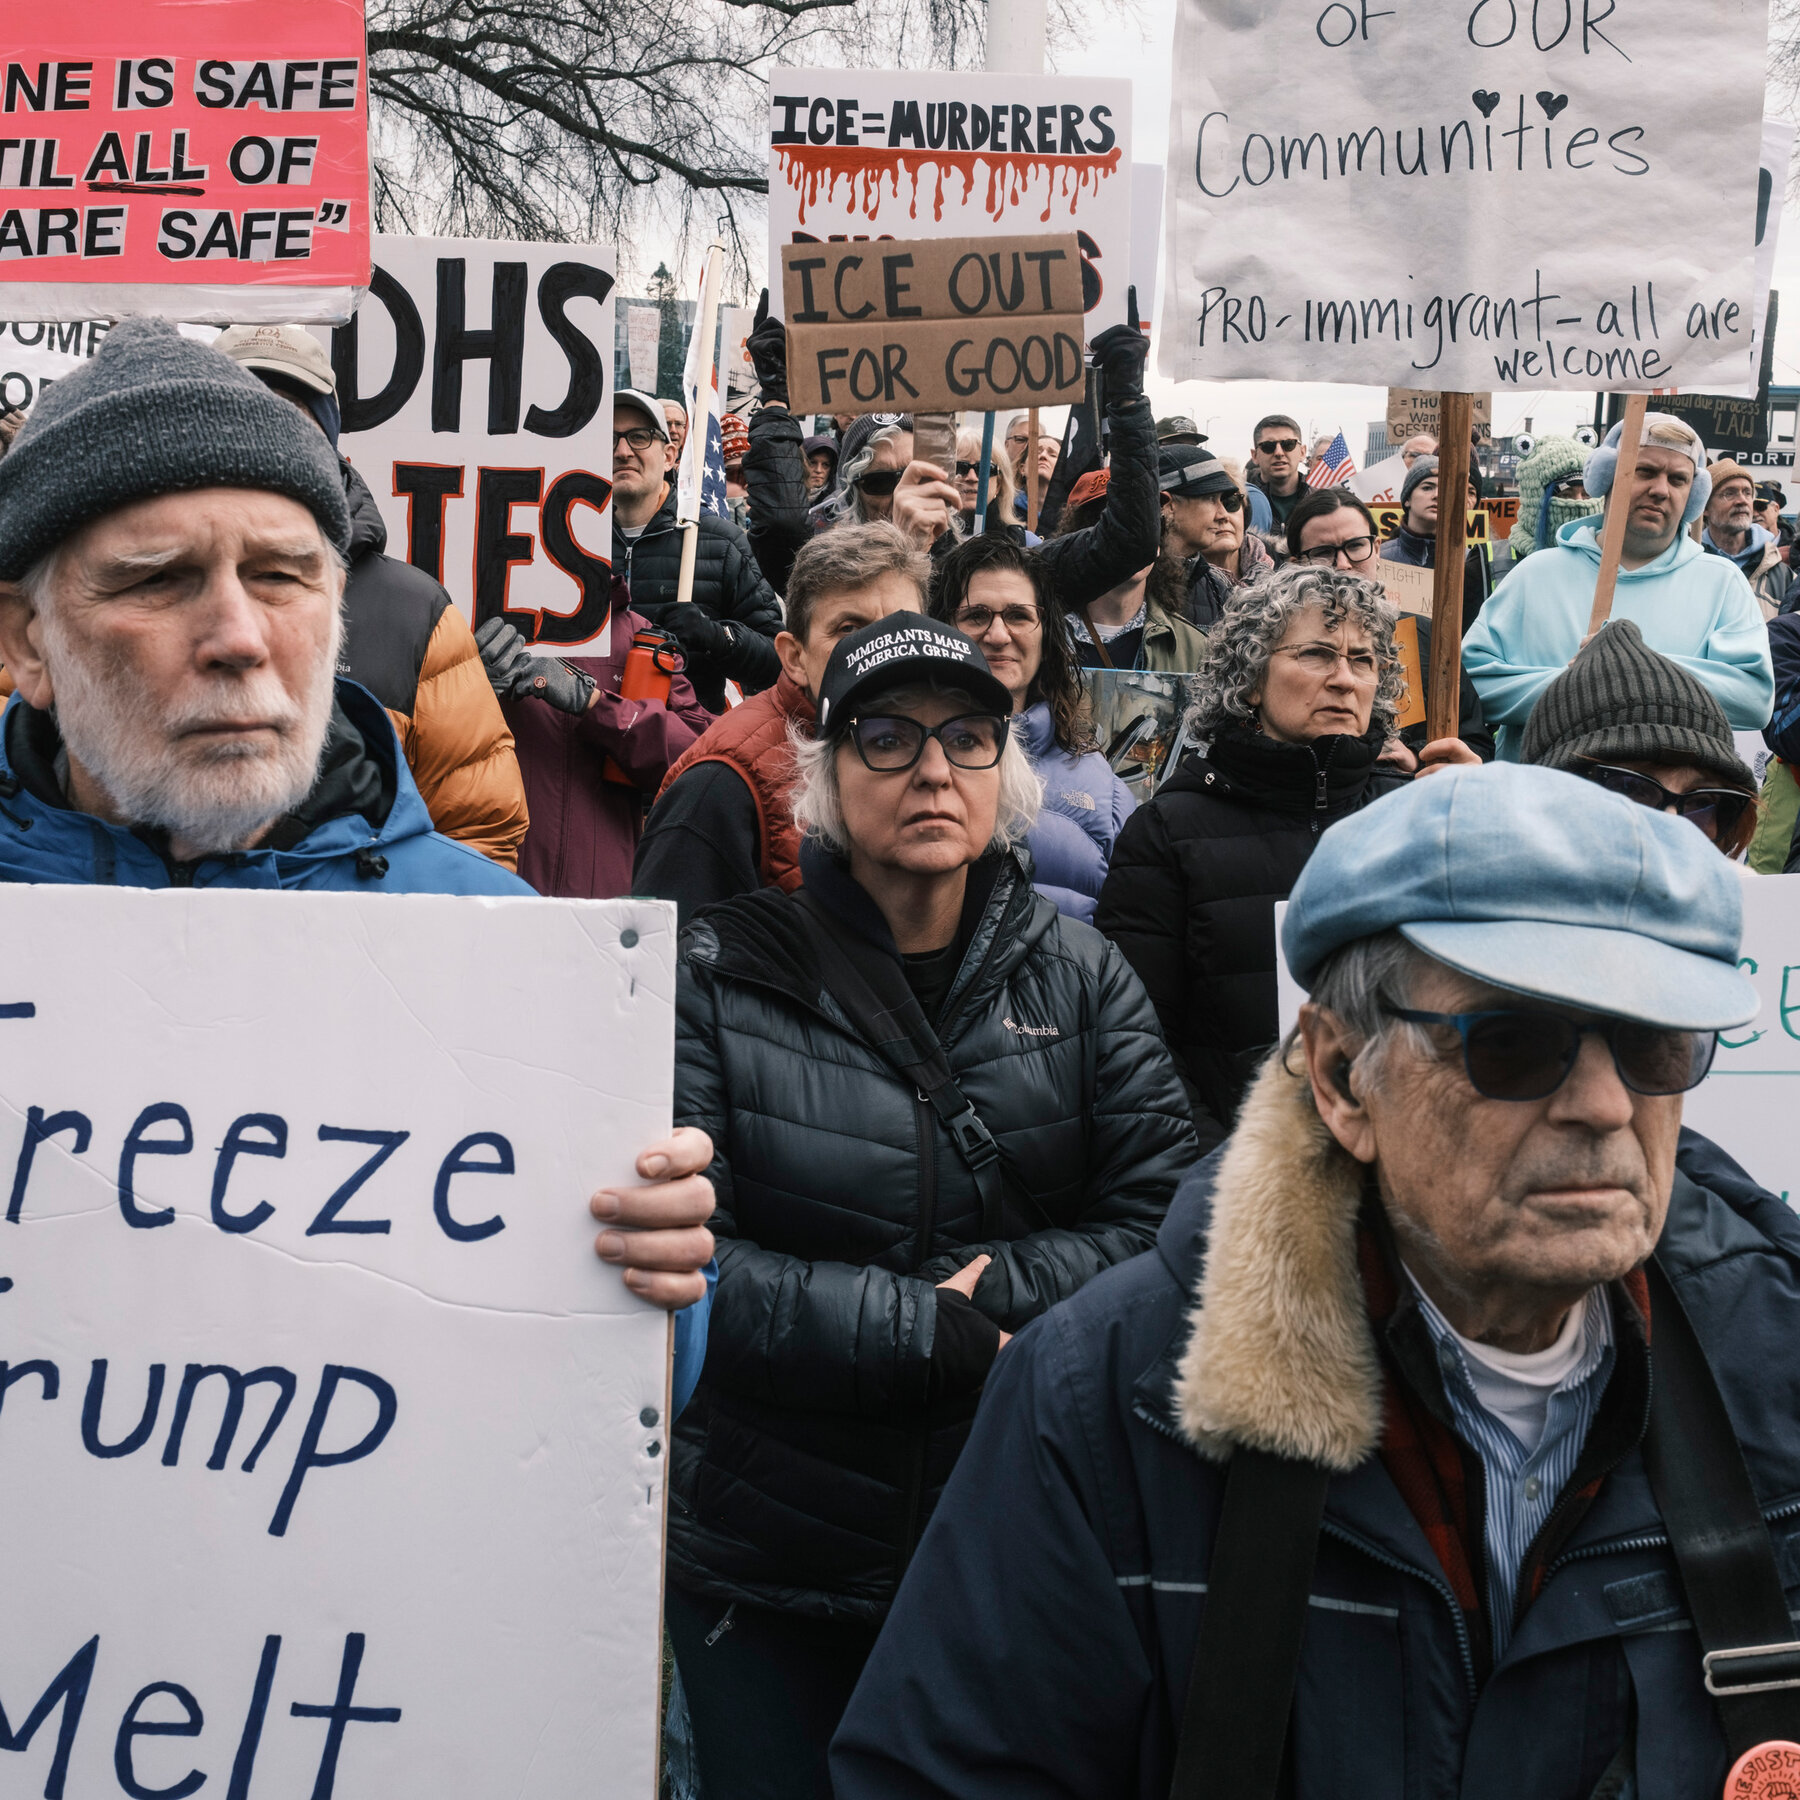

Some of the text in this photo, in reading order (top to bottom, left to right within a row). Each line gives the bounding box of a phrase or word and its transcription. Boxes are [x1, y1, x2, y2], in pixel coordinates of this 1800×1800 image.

[1467, 0, 1633, 63] OUR
[3, 58, 359, 113] NE IS SAFE
[85, 131, 206, 183] ALL
[229, 136, 318, 185] OF
[1196, 90, 1650, 197] Communities
[0, 207, 124, 257] ARE
[788, 253, 922, 323] ICE
[948, 249, 1067, 315] OUT
[1686, 298, 1740, 340] are
[331, 257, 616, 438] DHS
[816, 344, 920, 405] FOR
[945, 332, 1083, 397] GOOD
[1494, 340, 1673, 383] welcome
[1411, 398, 1440, 409] THU
[1713, 399, 1760, 419] process
[1714, 413, 1754, 439] LAW
[1384, 564, 1424, 585] FIGHT
[845, 628, 971, 669] IMMIGRANTS MAKE
[856, 643, 919, 676] AMERICA
[0, 1003, 516, 1242] reeze
[0, 1277, 398, 1538] rump
[1734, 1750, 1800, 1800] ESIST
